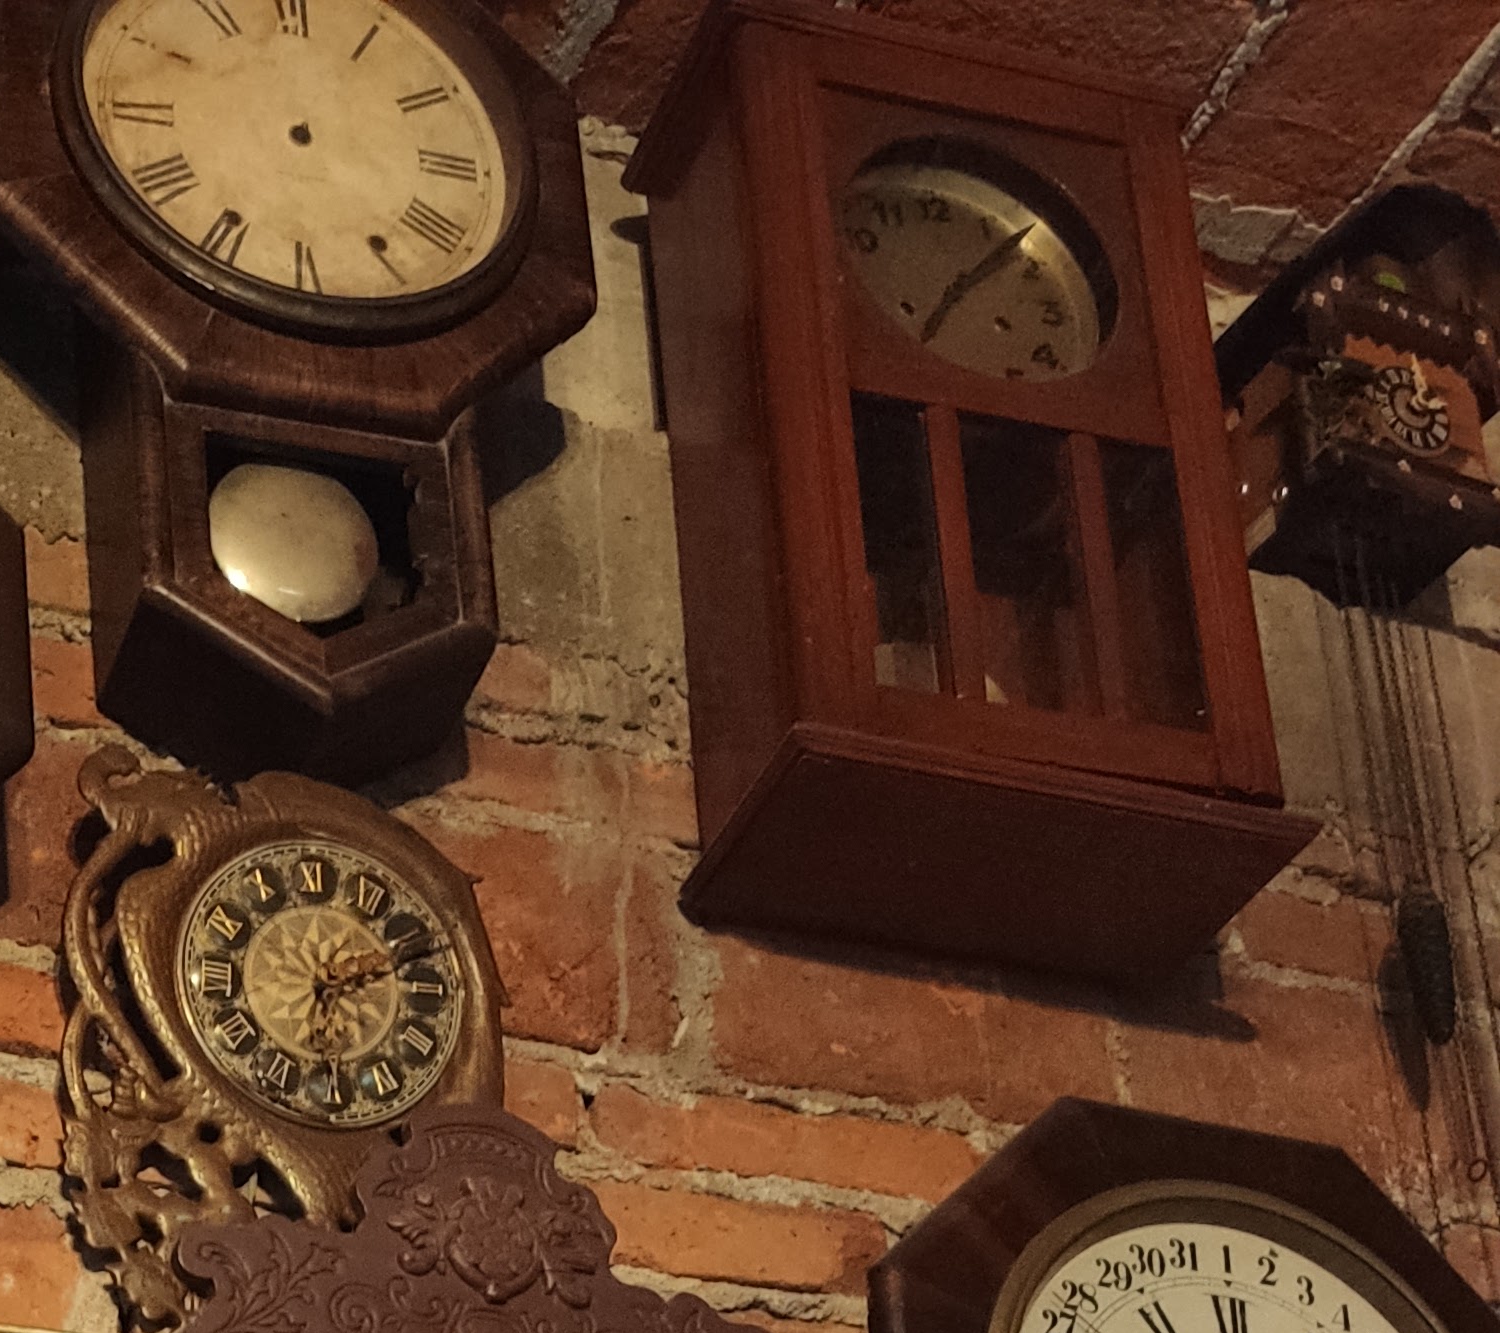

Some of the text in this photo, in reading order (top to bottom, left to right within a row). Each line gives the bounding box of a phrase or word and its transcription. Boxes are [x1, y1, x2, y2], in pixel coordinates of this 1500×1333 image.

[396, 86, 449, 113] II
[418, 149, 476, 182] III
[247, 868, 276, 902] X
[300, 861, 322, 893] XI
[358, 875, 386, 916] XII
[204, 905, 243, 940] IX
[201, 959, 232, 998] VIII
[412, 980, 443, 997] II
[216, 1011, 256, 1050] VII
[400, 1025, 434, 1057] III
[1129, 1243, 1166, 1278] 30
[1169, 1238, 1198, 1272] 31
[1222, 1244, 1232, 1274] 1
[1258, 1256, 1278, 1286] 2
[1096, 1258, 1133, 1291] 29
[1297, 1275, 1315, 1306] 3
[1062, 1279, 1099, 1314] 28
[1331, 1304, 1352, 1332] 4
